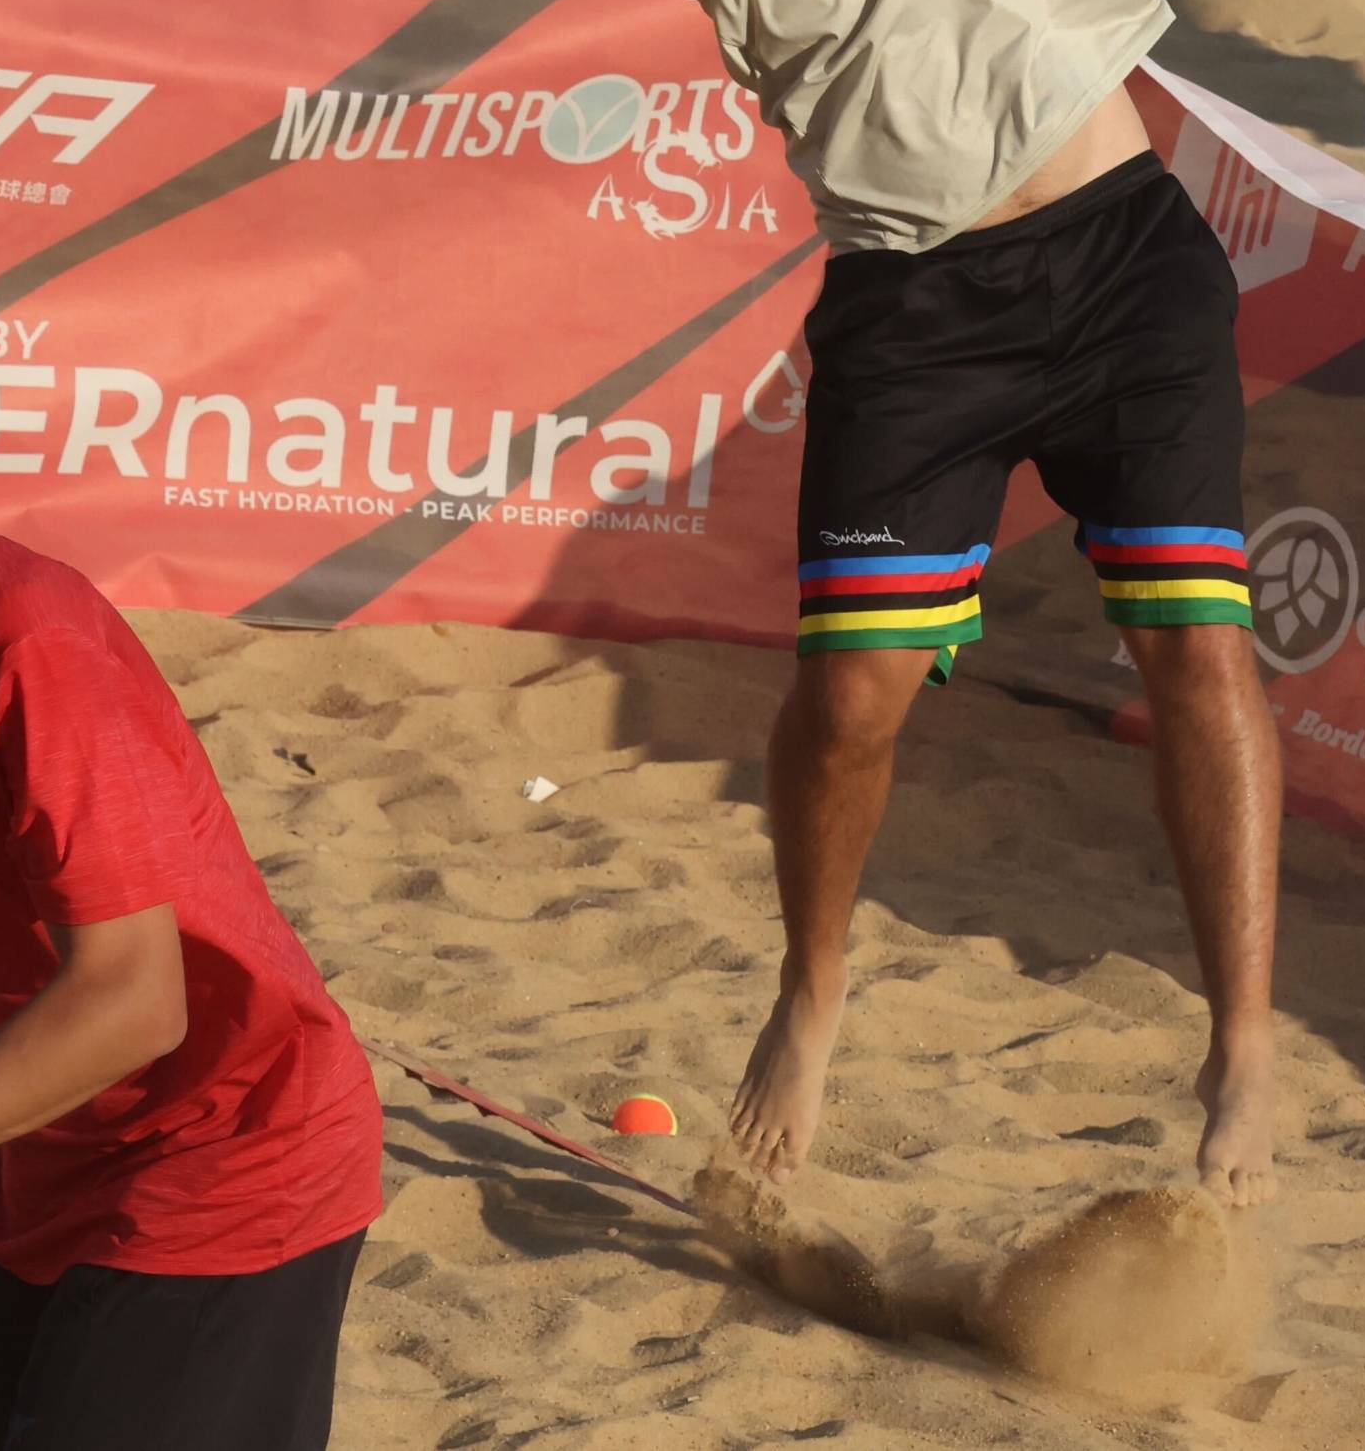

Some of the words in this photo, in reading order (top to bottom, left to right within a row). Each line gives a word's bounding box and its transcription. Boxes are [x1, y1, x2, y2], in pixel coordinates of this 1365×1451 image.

[164, 486, 229, 509] FAST
[238, 490, 395, 517] HYDRATION
[422, 501, 493, 523] PEAK
[502, 505, 707, 535] PERFORMANCE
